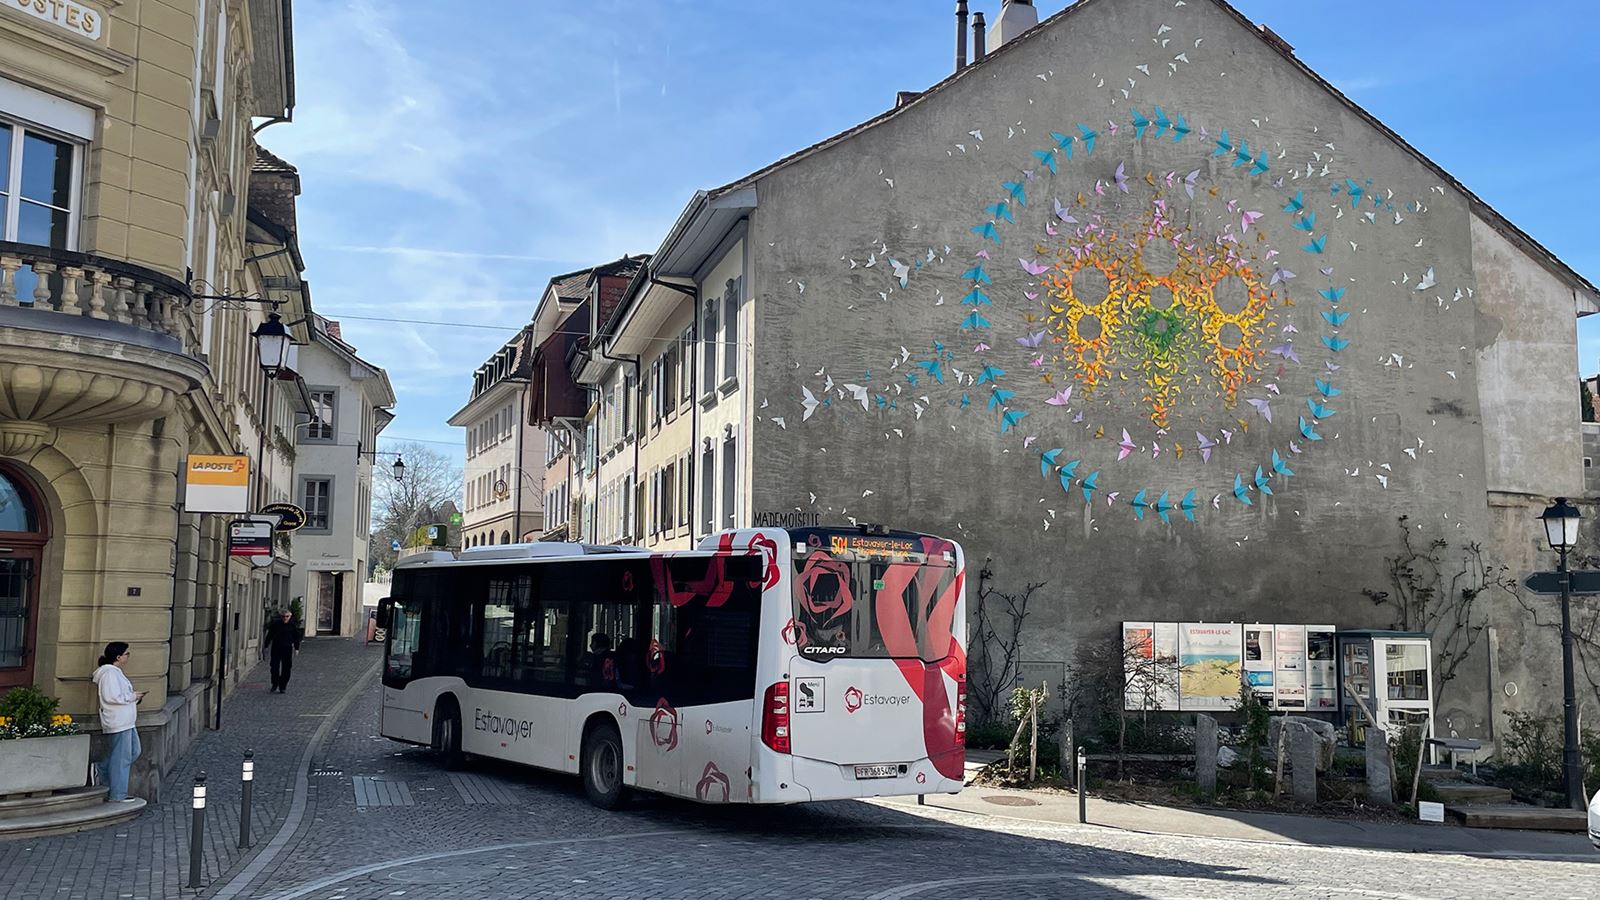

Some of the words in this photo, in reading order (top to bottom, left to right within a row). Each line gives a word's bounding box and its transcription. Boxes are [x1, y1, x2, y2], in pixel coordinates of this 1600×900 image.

[204, 462, 233, 470] POSTE
[830, 536, 848, 554] 501
[803, 646, 846, 654] CITARO
[864, 694, 911, 706] Estavayer
[474, 707, 534, 742] Estavayer
